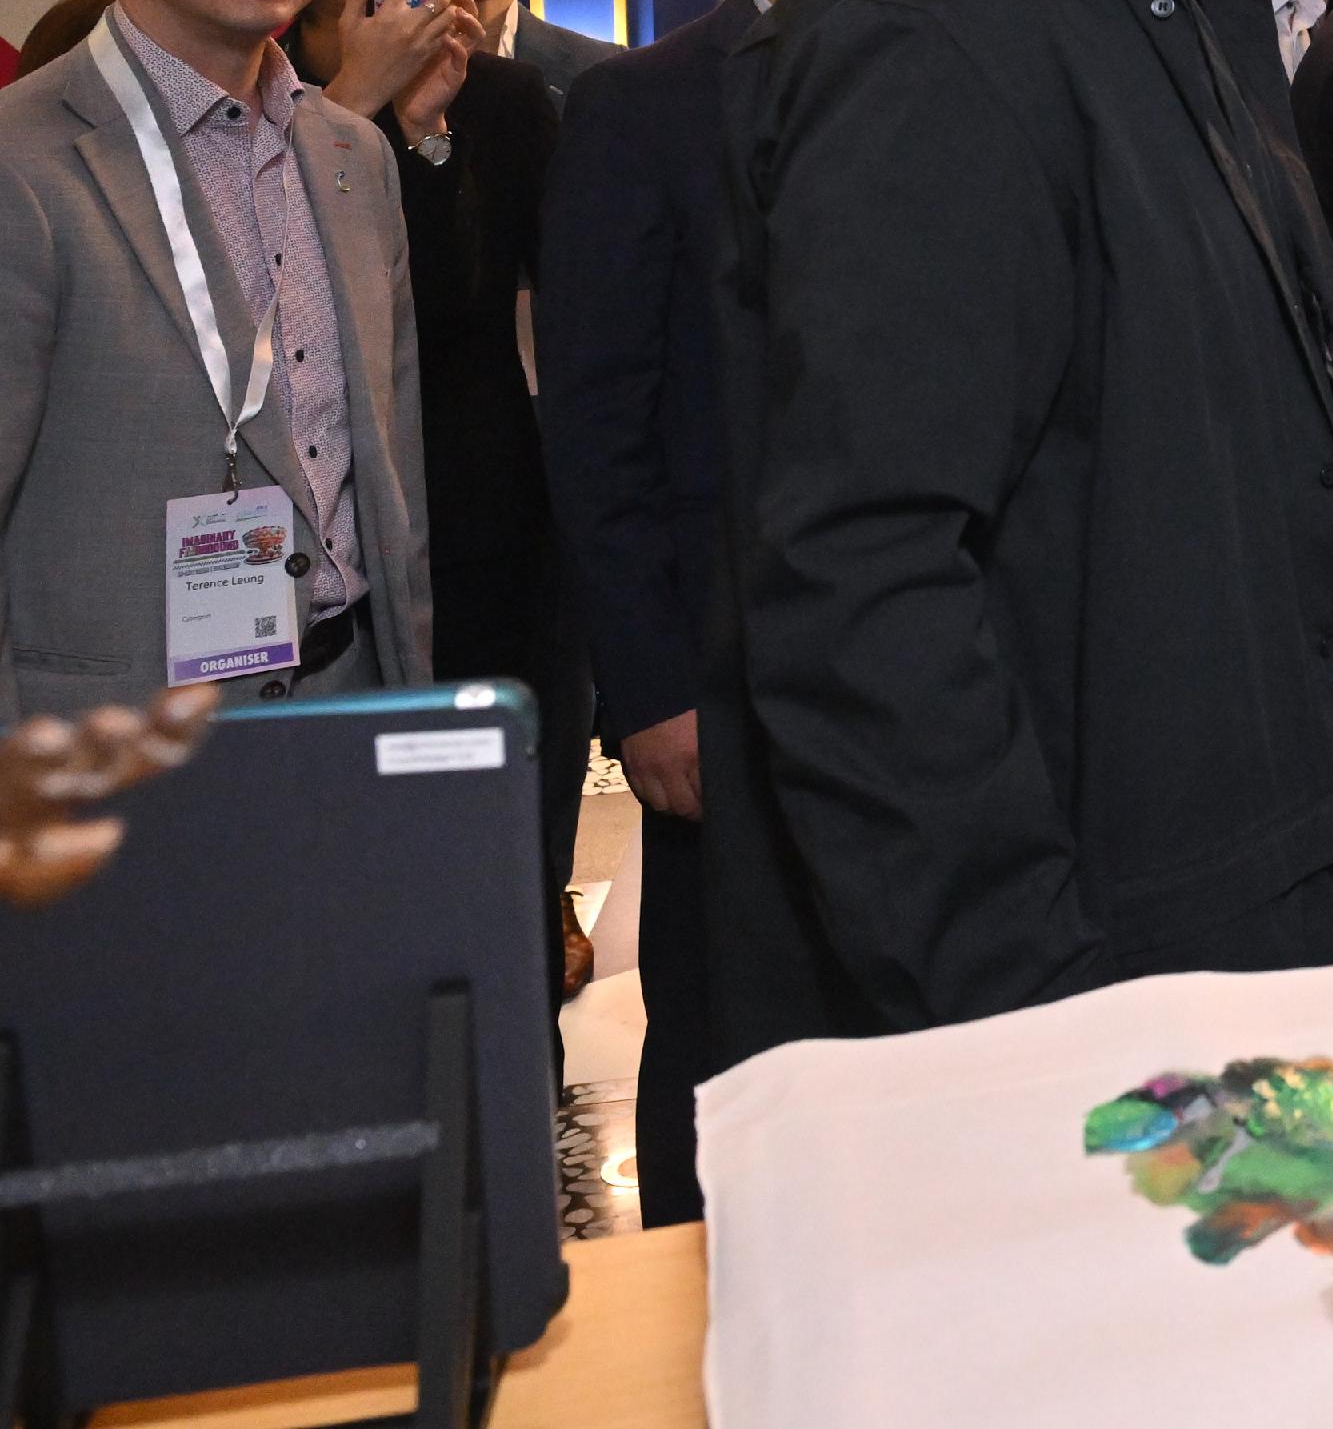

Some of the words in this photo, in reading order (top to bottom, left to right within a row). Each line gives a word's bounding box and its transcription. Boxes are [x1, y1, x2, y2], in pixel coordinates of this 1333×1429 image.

[186, 578, 230, 591] Terence
[231, 574, 265, 586] Leung
[200, 651, 269, 673] ORGANISER
